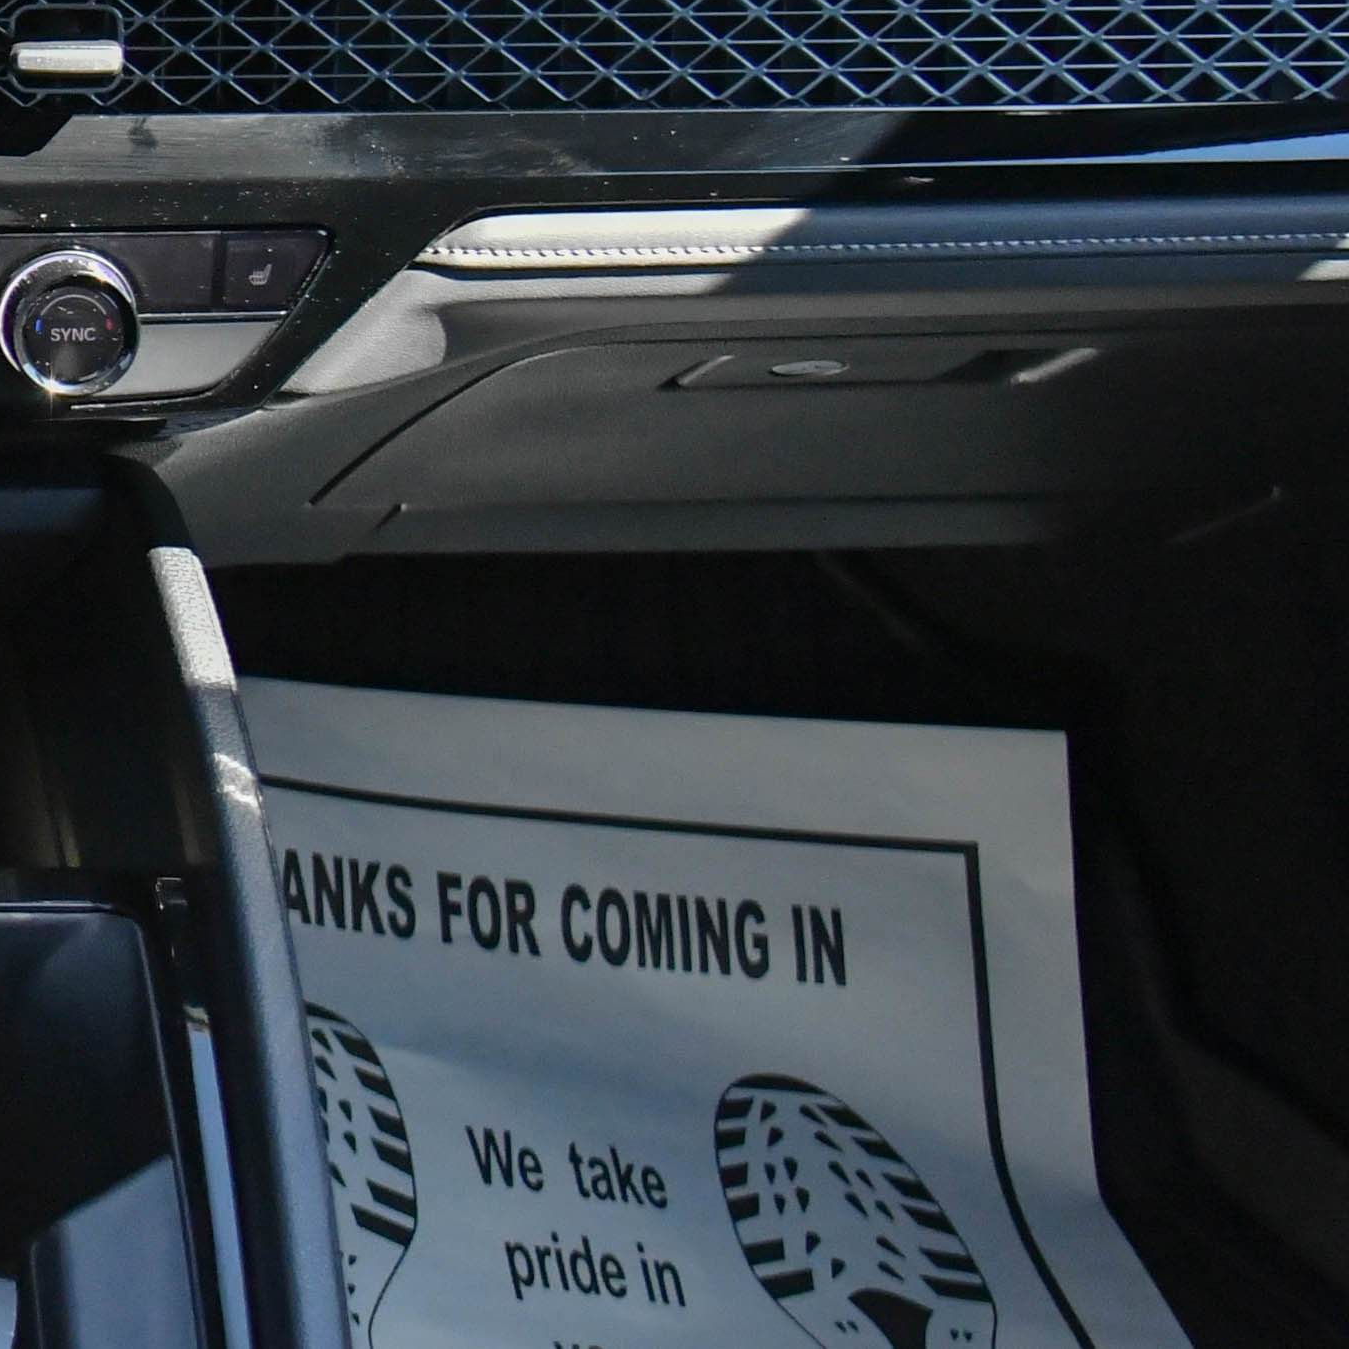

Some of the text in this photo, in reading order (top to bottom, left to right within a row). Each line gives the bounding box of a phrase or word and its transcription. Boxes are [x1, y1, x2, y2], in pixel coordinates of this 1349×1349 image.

[50, 327, 97, 342] SYNC
[282, 847, 849, 988] ANKS FOR COMING IN
[464, 1124, 669, 1211] We take
[504, 1229, 688, 1308] pride in
